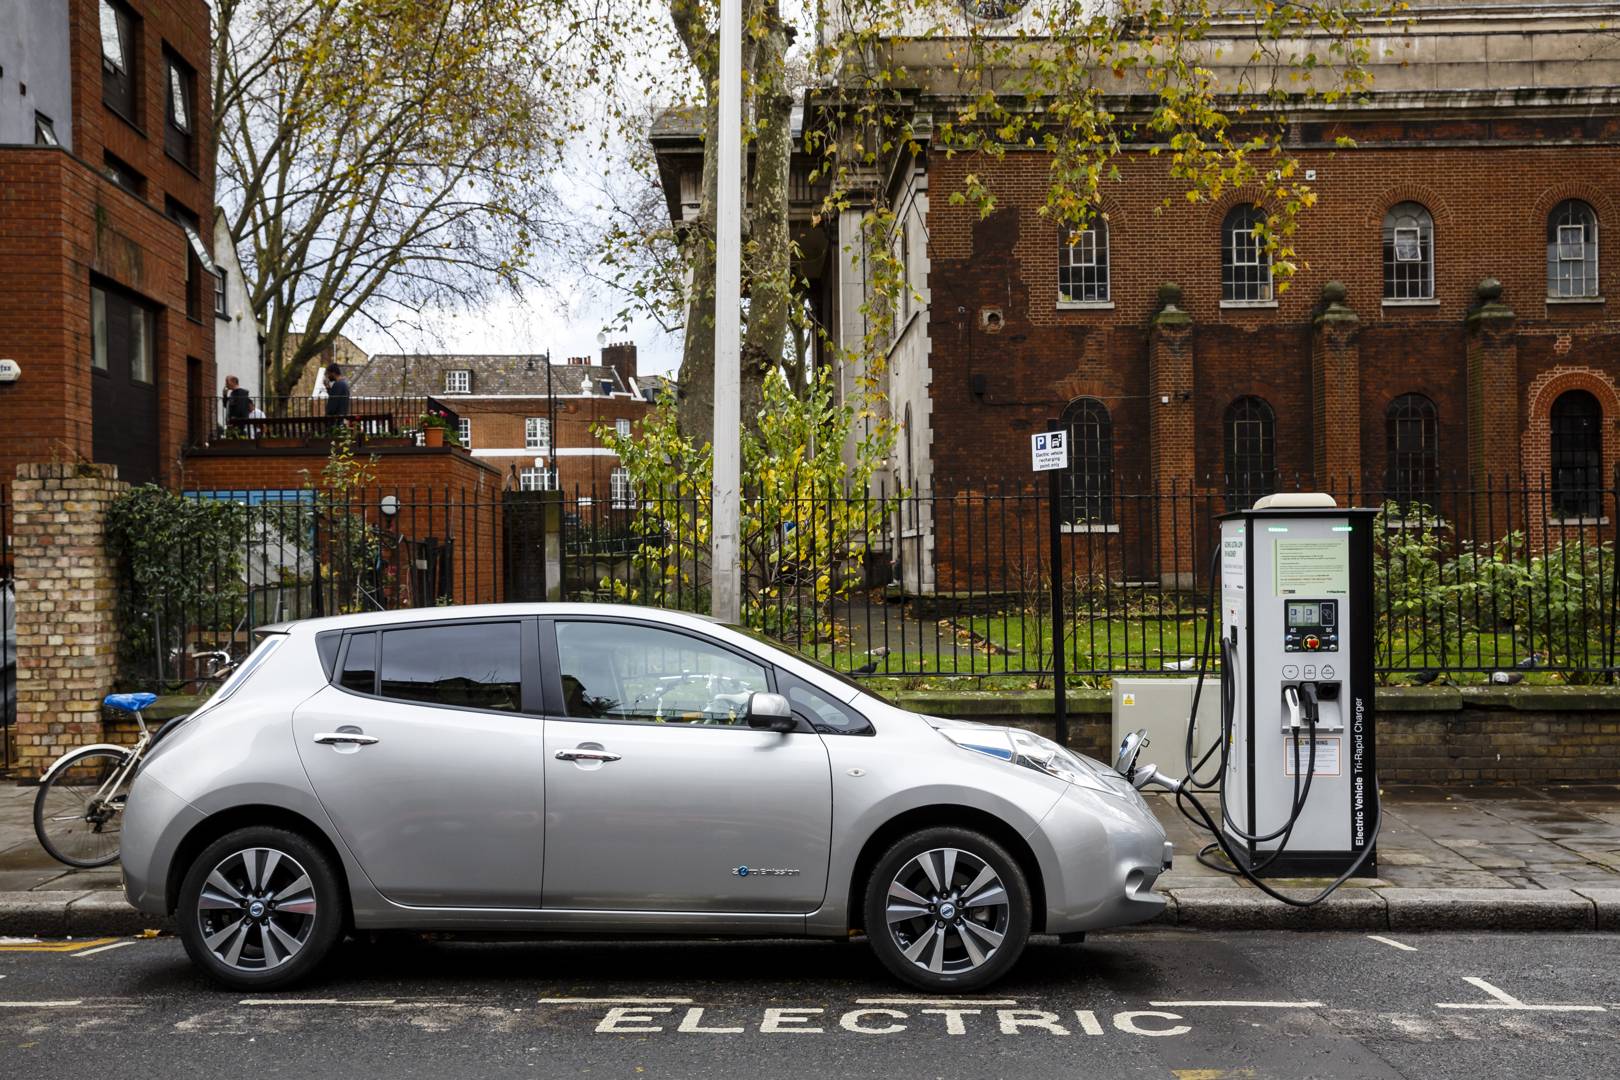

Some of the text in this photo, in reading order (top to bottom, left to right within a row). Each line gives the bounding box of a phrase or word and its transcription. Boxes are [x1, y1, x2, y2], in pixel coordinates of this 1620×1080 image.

[1037, 437, 1045, 449] P
[1354, 697, 1365, 846] Electric Vehicle Tri-Rapid Charger
[760, 867, 800, 876] Emission
[595, 1007, 1192, 1036] ELECTRIC
